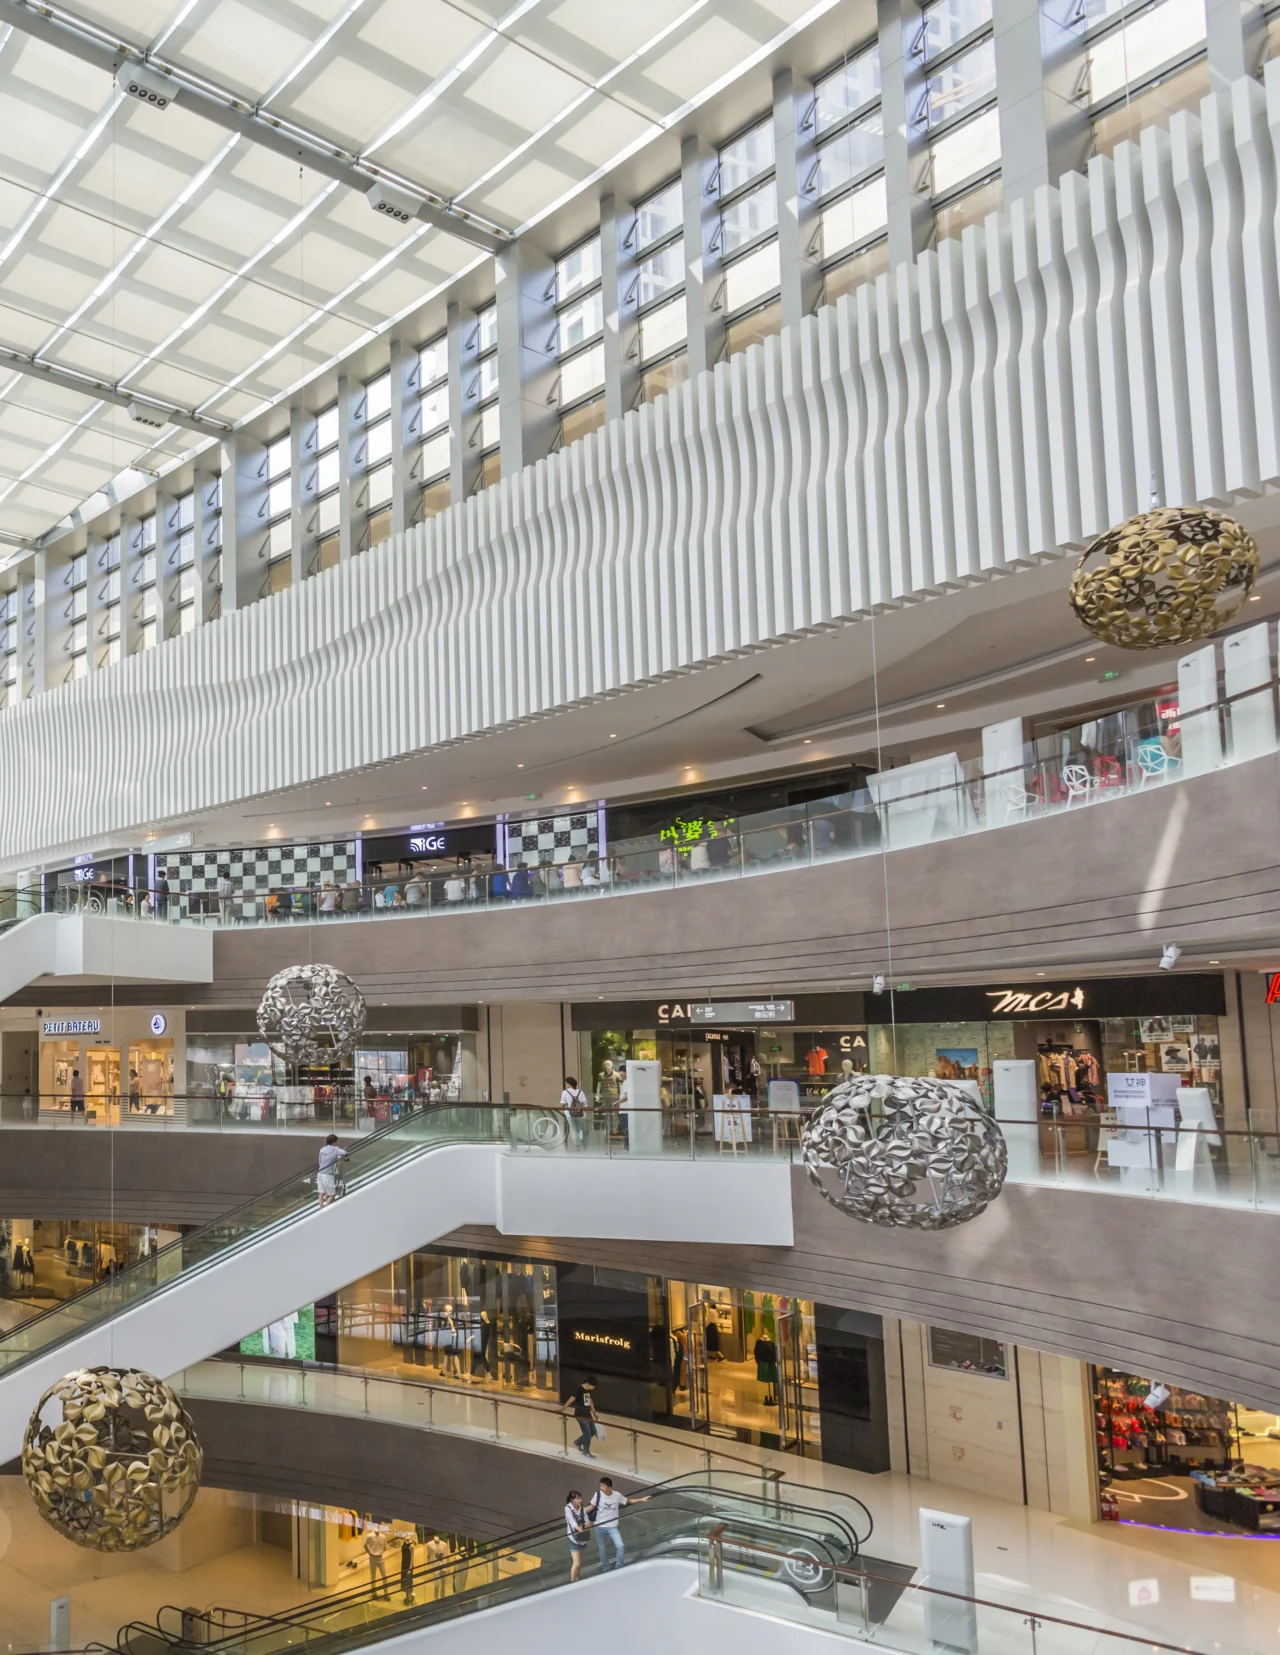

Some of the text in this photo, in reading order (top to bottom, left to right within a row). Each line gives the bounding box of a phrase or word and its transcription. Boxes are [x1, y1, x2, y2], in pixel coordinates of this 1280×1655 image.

[43, 1020, 100, 1033] PETIT BATEAU
[1125, 1077, 1146, 1088] 女神
[574, 1331, 631, 1349] Marisfrolg
